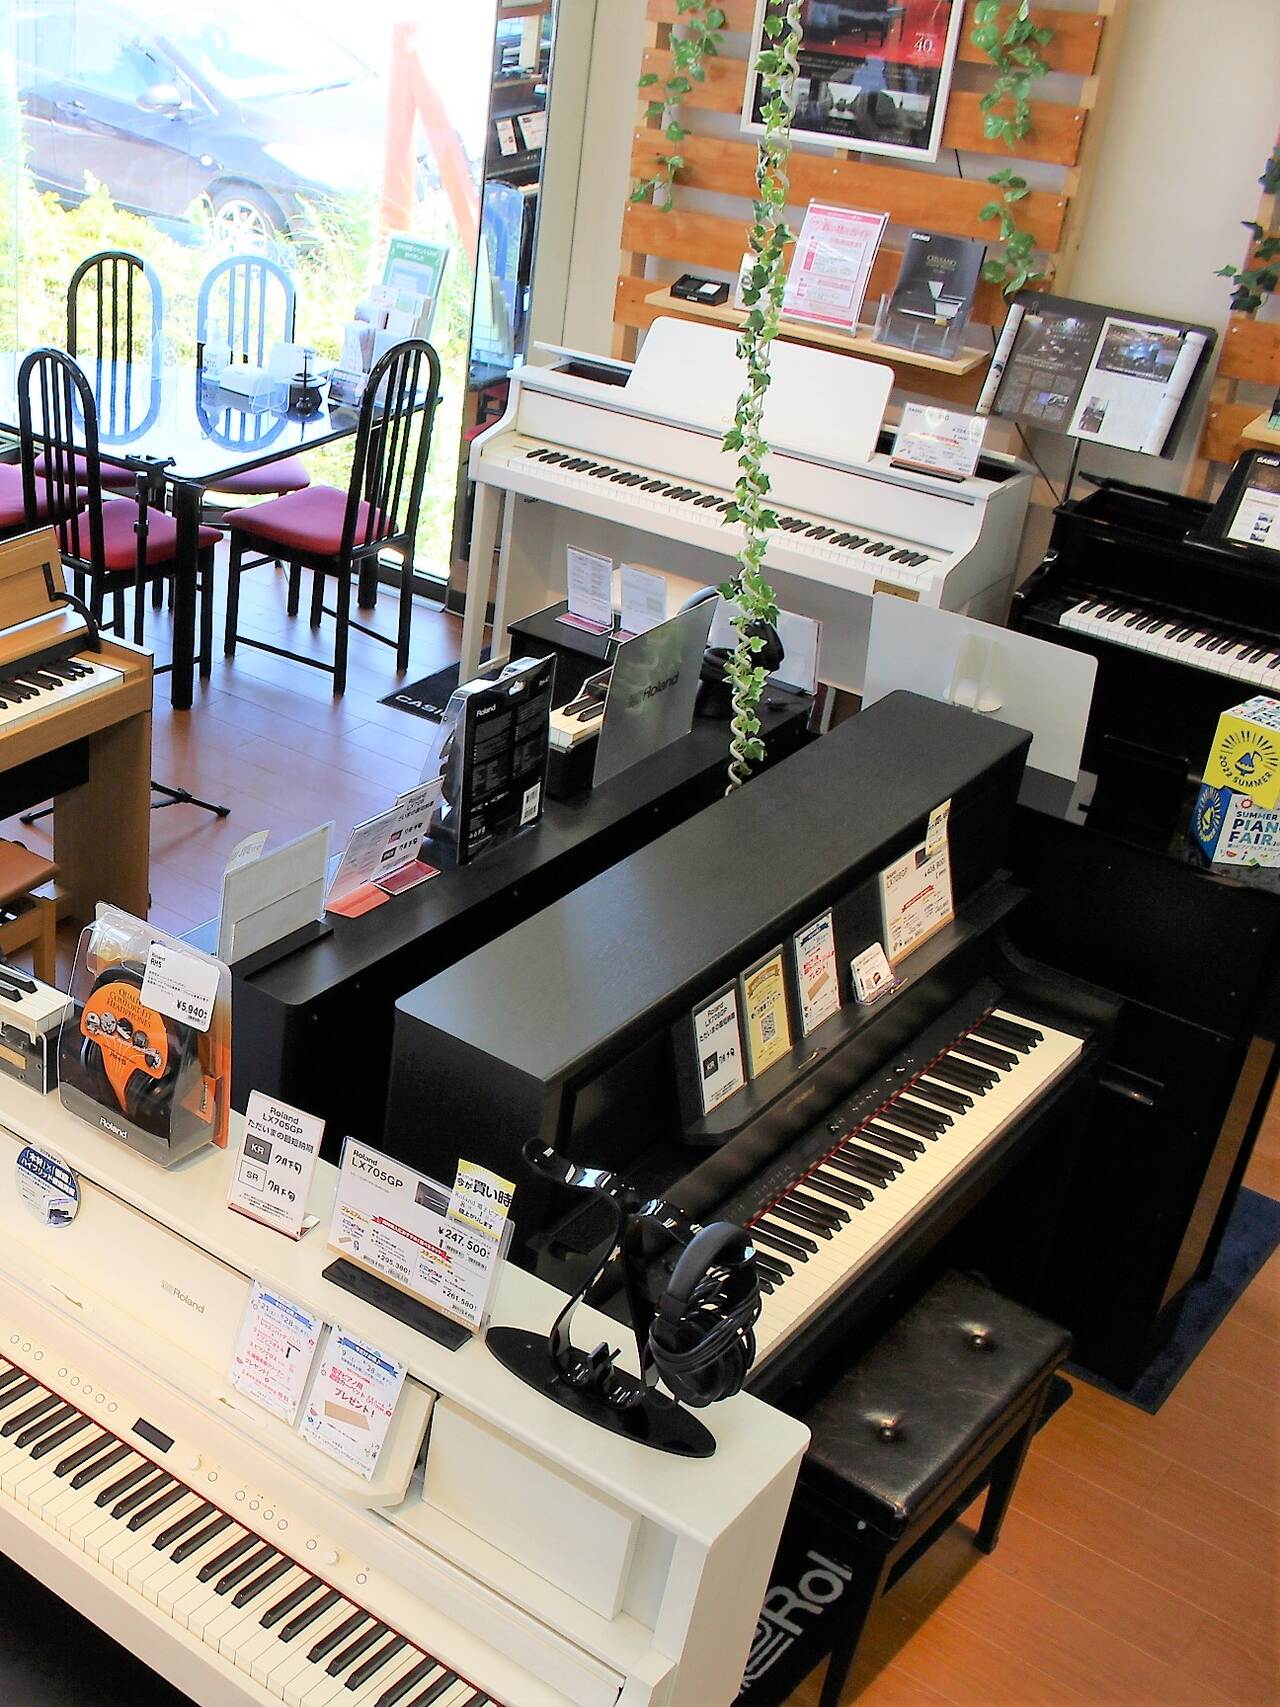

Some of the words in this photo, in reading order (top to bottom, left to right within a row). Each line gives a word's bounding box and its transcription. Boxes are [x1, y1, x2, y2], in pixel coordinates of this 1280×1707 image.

[1257, 456, 1280, 468] CASIO
[643, 671, 680, 701] Roland
[395, 694, 443, 717] CASI
[476, 703, 497, 718] Roland
[1219, 755, 1233, 778] 2022
[1233, 771, 1272, 788] SUMMER
[1232, 818, 1280, 834] PIAN
[1236, 810, 1278, 822] SUMMER
[1229, 831, 1273, 846] FAIR
[151, 953, 166, 962] Roland
[106, 999, 152, 1029] HEADPHONES
[177, 1000, 204, 1019] ¥5,940
[707, 1001, 724, 1017] Roland
[262, 1112, 304, 1135] LX705GP
[270, 1106, 300, 1125] Roland
[99, 1116, 128, 1140] Roland
[247, 1119, 314, 1154] ただいまの最短納期
[251, 1143, 266, 1155] KR
[352, 1149, 378, 1167] Roland
[246, 1170, 259, 1181] SR
[351, 1157, 404, 1188] LX705GP
[456, 1177, 513, 1208] 今が買い時
[458, 1207, 493, 1230] 値上がりします
[173, 1287, 205, 1314] Roland
[334, 1386, 376, 1418] プレゼント!
[761, 1550, 853, 1637] Rol
